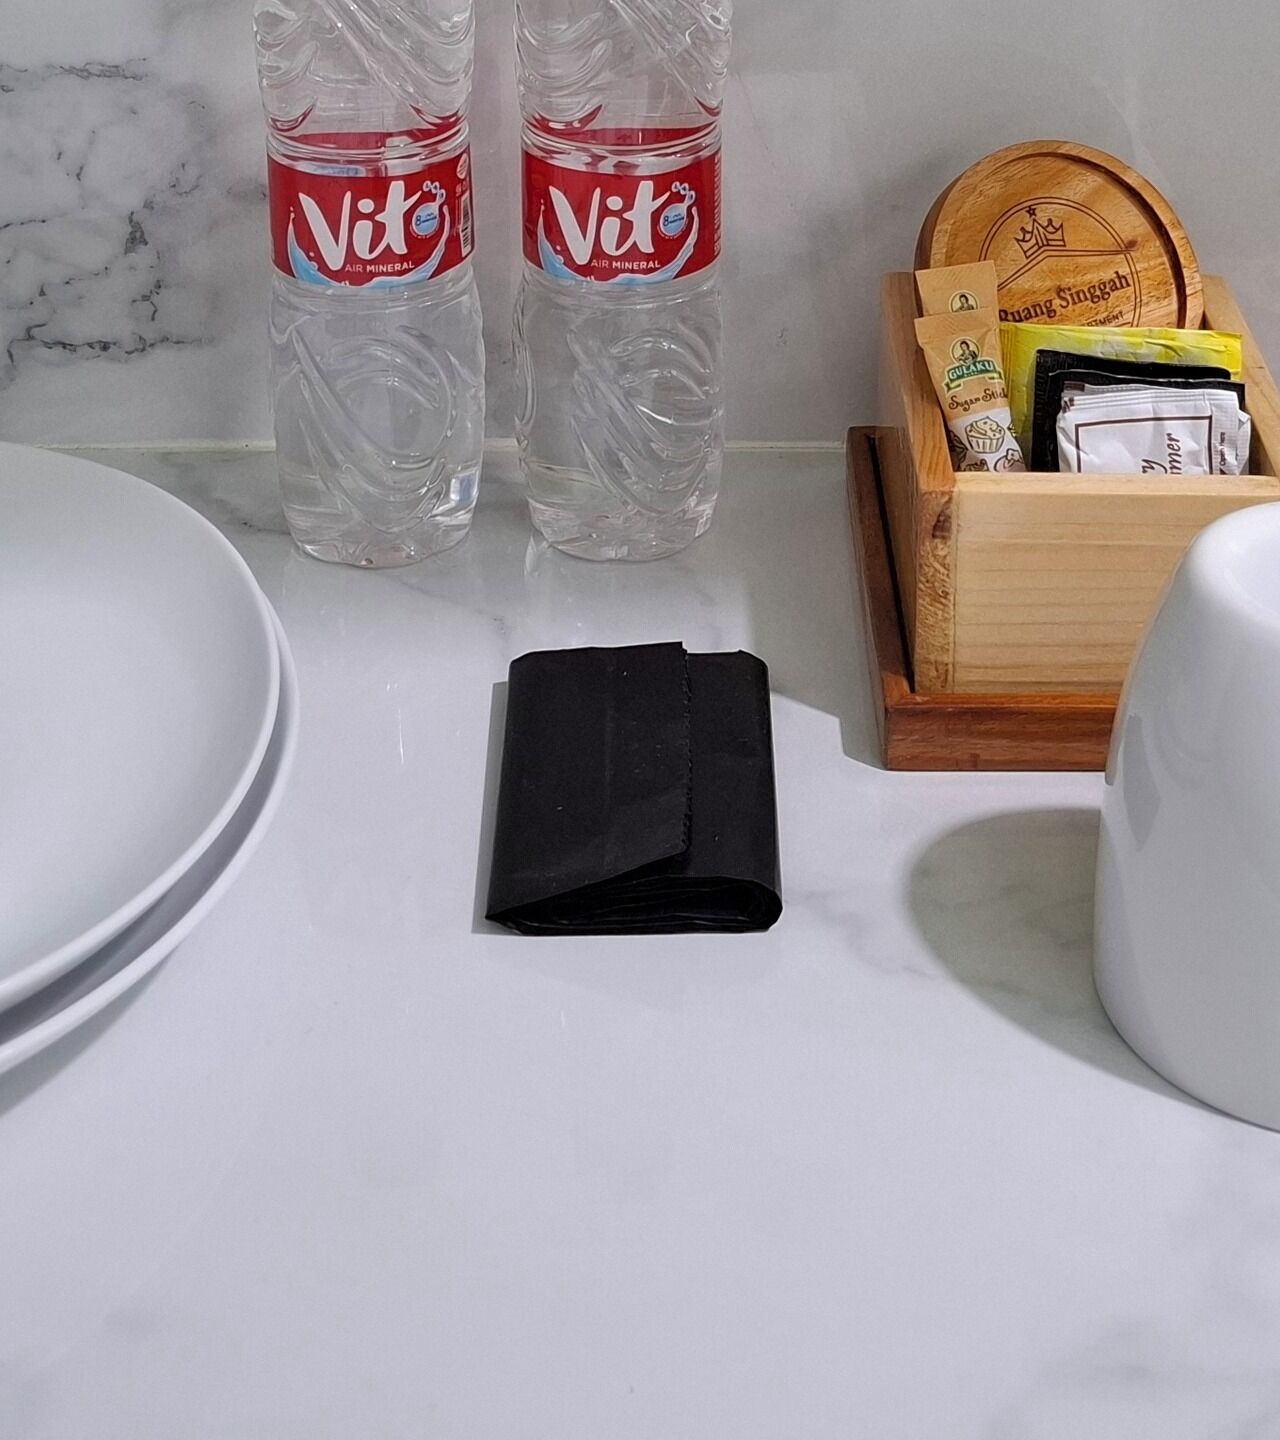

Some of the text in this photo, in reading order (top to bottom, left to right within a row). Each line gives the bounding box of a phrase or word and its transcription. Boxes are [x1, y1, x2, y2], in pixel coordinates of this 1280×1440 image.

[344, 260, 415, 274] AIR MINERAL
[591, 259, 661, 270] AIR MINERAL
[1056, 270, 1132, 309] Singgah
[948, 360, 994, 380] GULAKU
